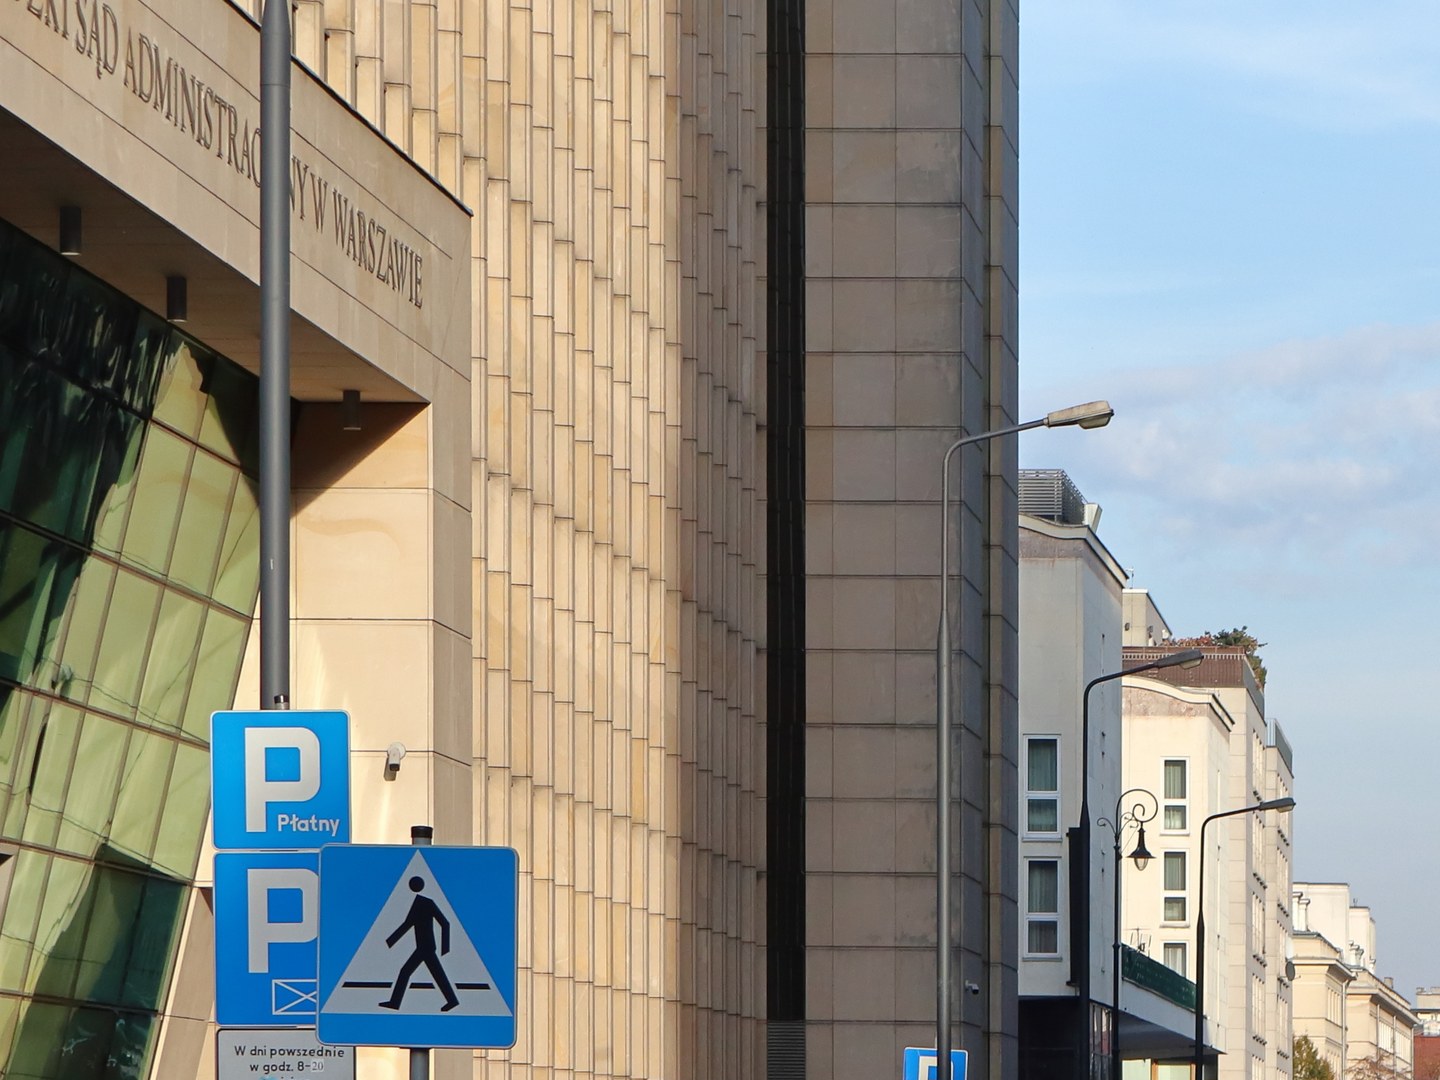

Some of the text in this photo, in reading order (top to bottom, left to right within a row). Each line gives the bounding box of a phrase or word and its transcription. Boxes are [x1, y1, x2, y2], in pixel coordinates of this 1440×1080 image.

[311, 171, 329, 235] W
[332, 186, 423, 309] WARSZAWIE
[244, 727, 321, 832] P
[277, 814, 340, 837] Płatny
[247, 868, 319, 973] P
[234, 1045, 345, 1058] W dni powszednie
[249, 1060, 324, 1075] w godz. 8-20
